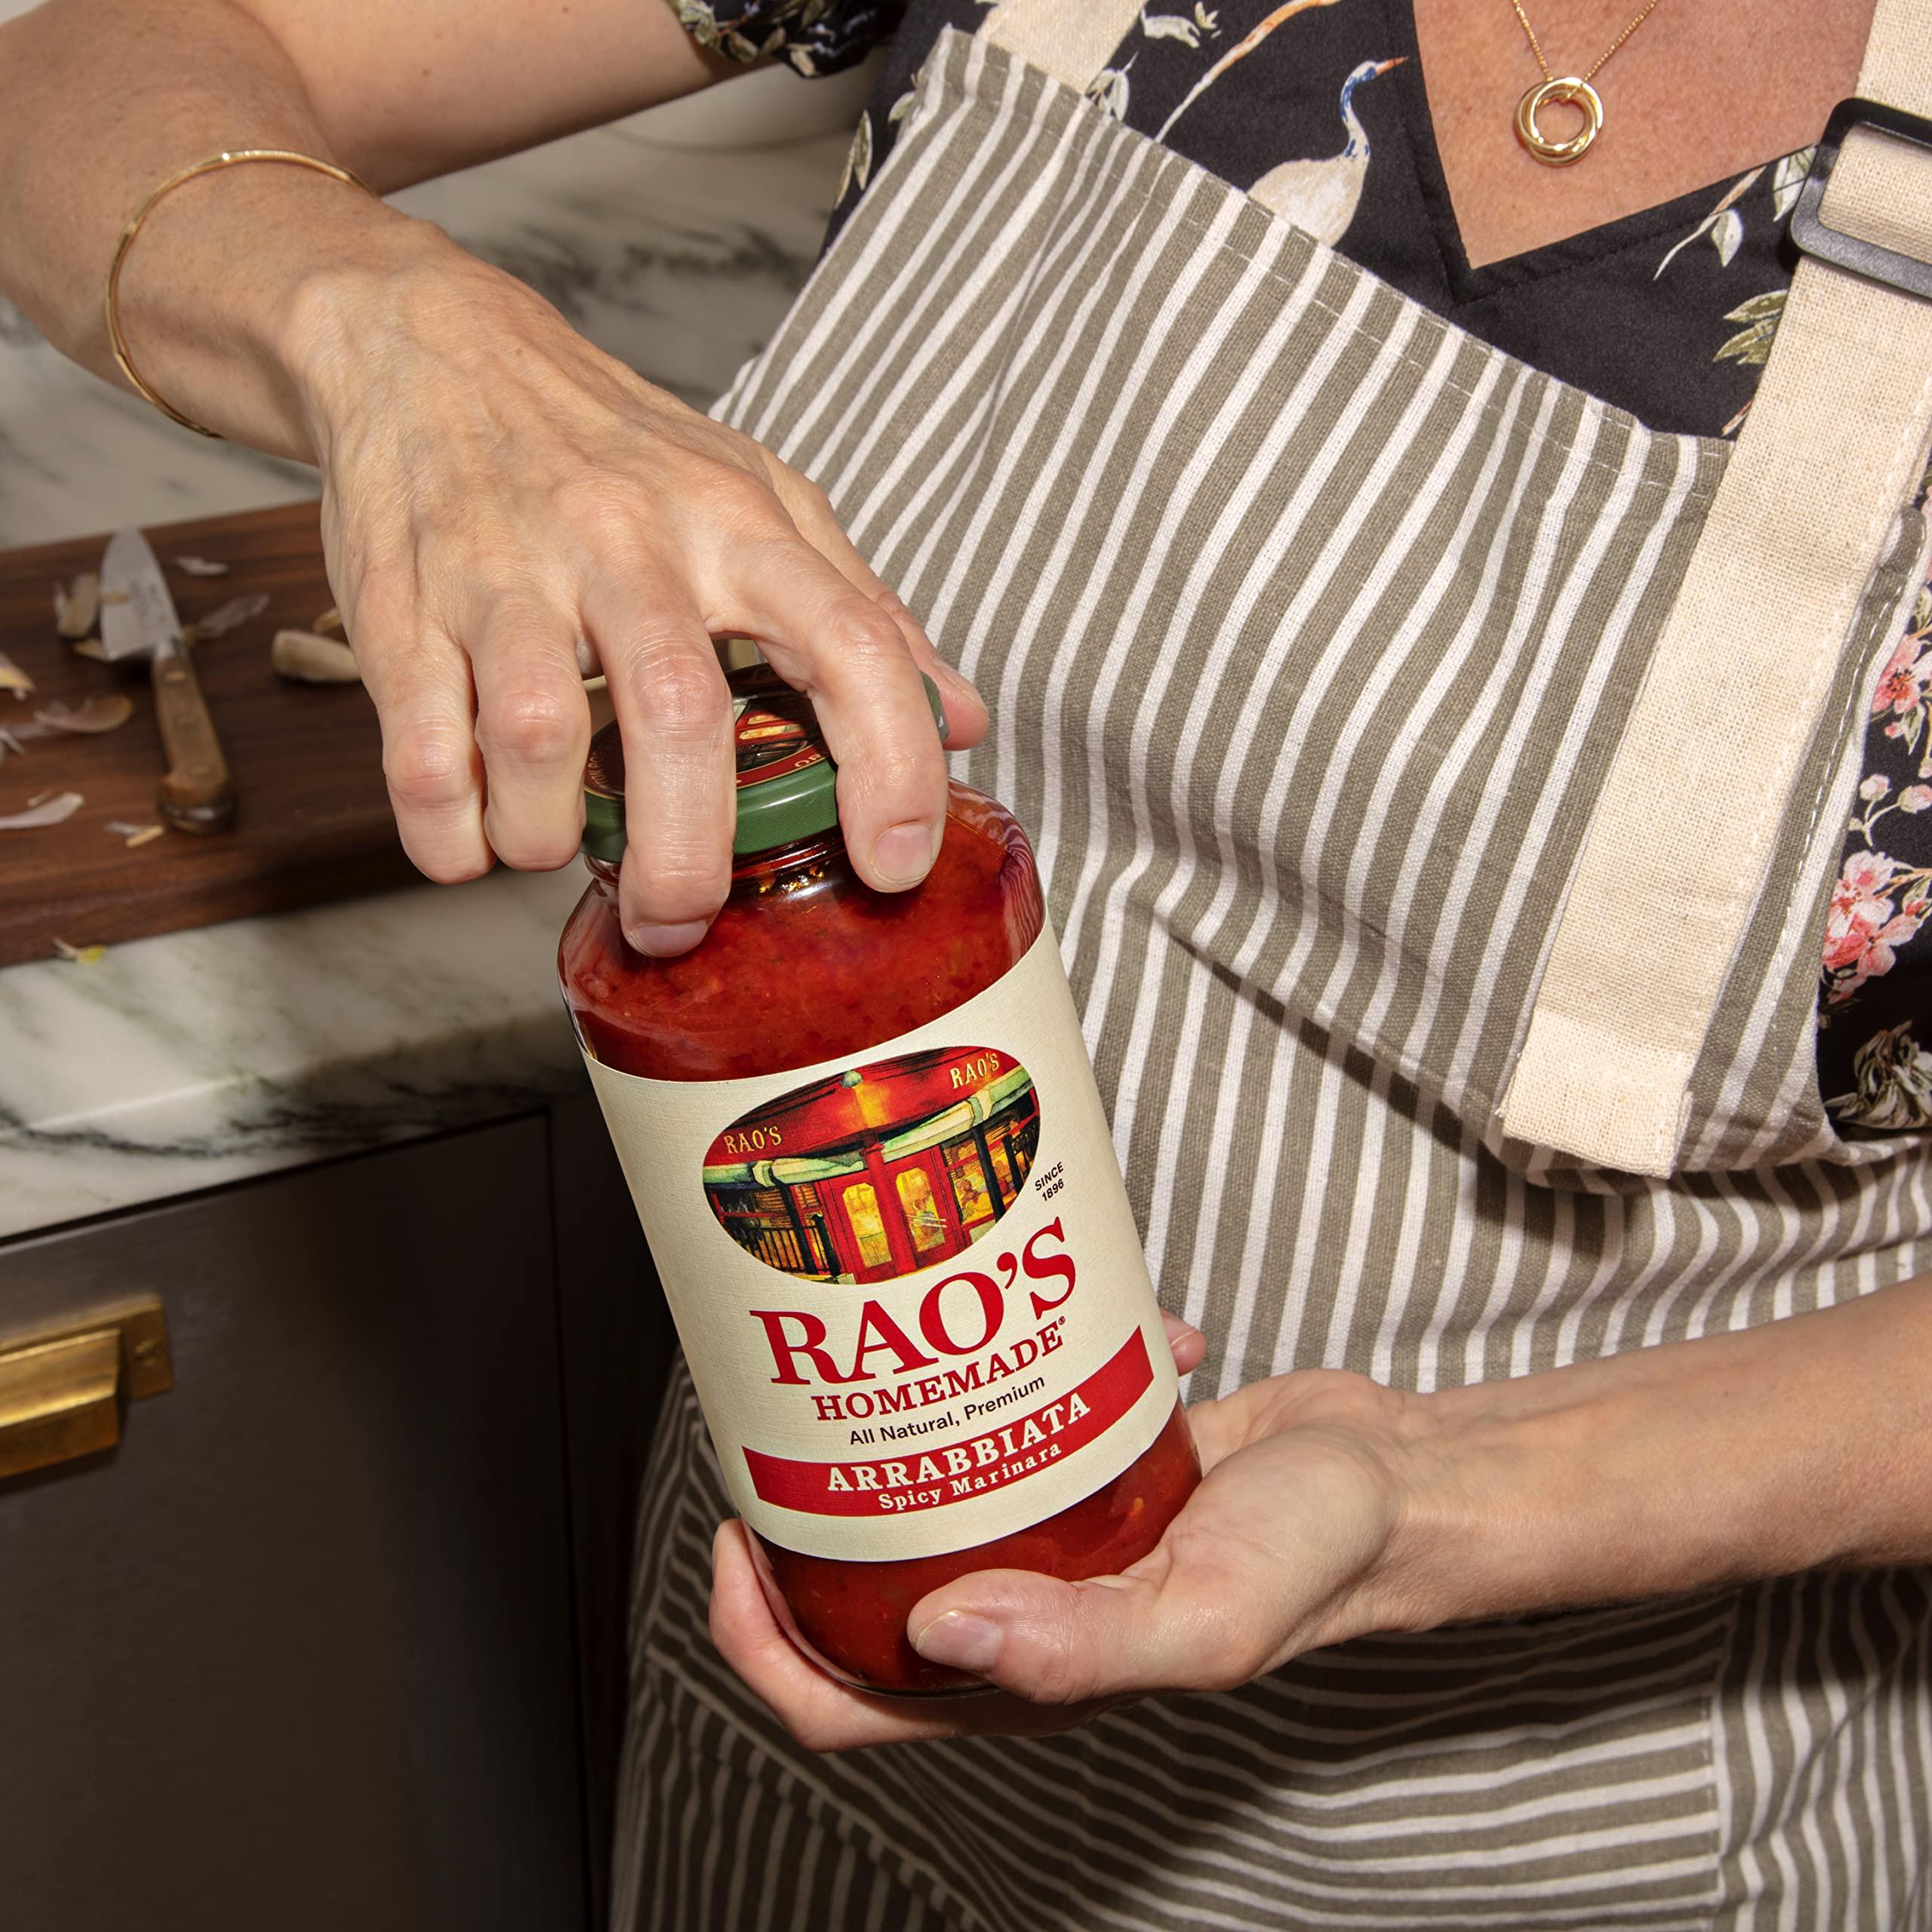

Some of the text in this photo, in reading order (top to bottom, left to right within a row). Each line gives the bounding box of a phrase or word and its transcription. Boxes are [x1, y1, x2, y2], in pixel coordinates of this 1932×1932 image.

[950, 1052, 1000, 1090] RAO'S
[723, 1125, 782, 1154] RAO'S
[1035, 1161, 1064, 1191] SINCE
[1041, 1179, 1065, 1202] 1896
[749, 1217, 1076, 1385] RAO'S
[850, 1376, 1045, 1445] All Natural, Premium
[827, 1392, 1091, 1492] ARRABBIATA
[878, 1443, 1061, 1511] Spicy Marinara
